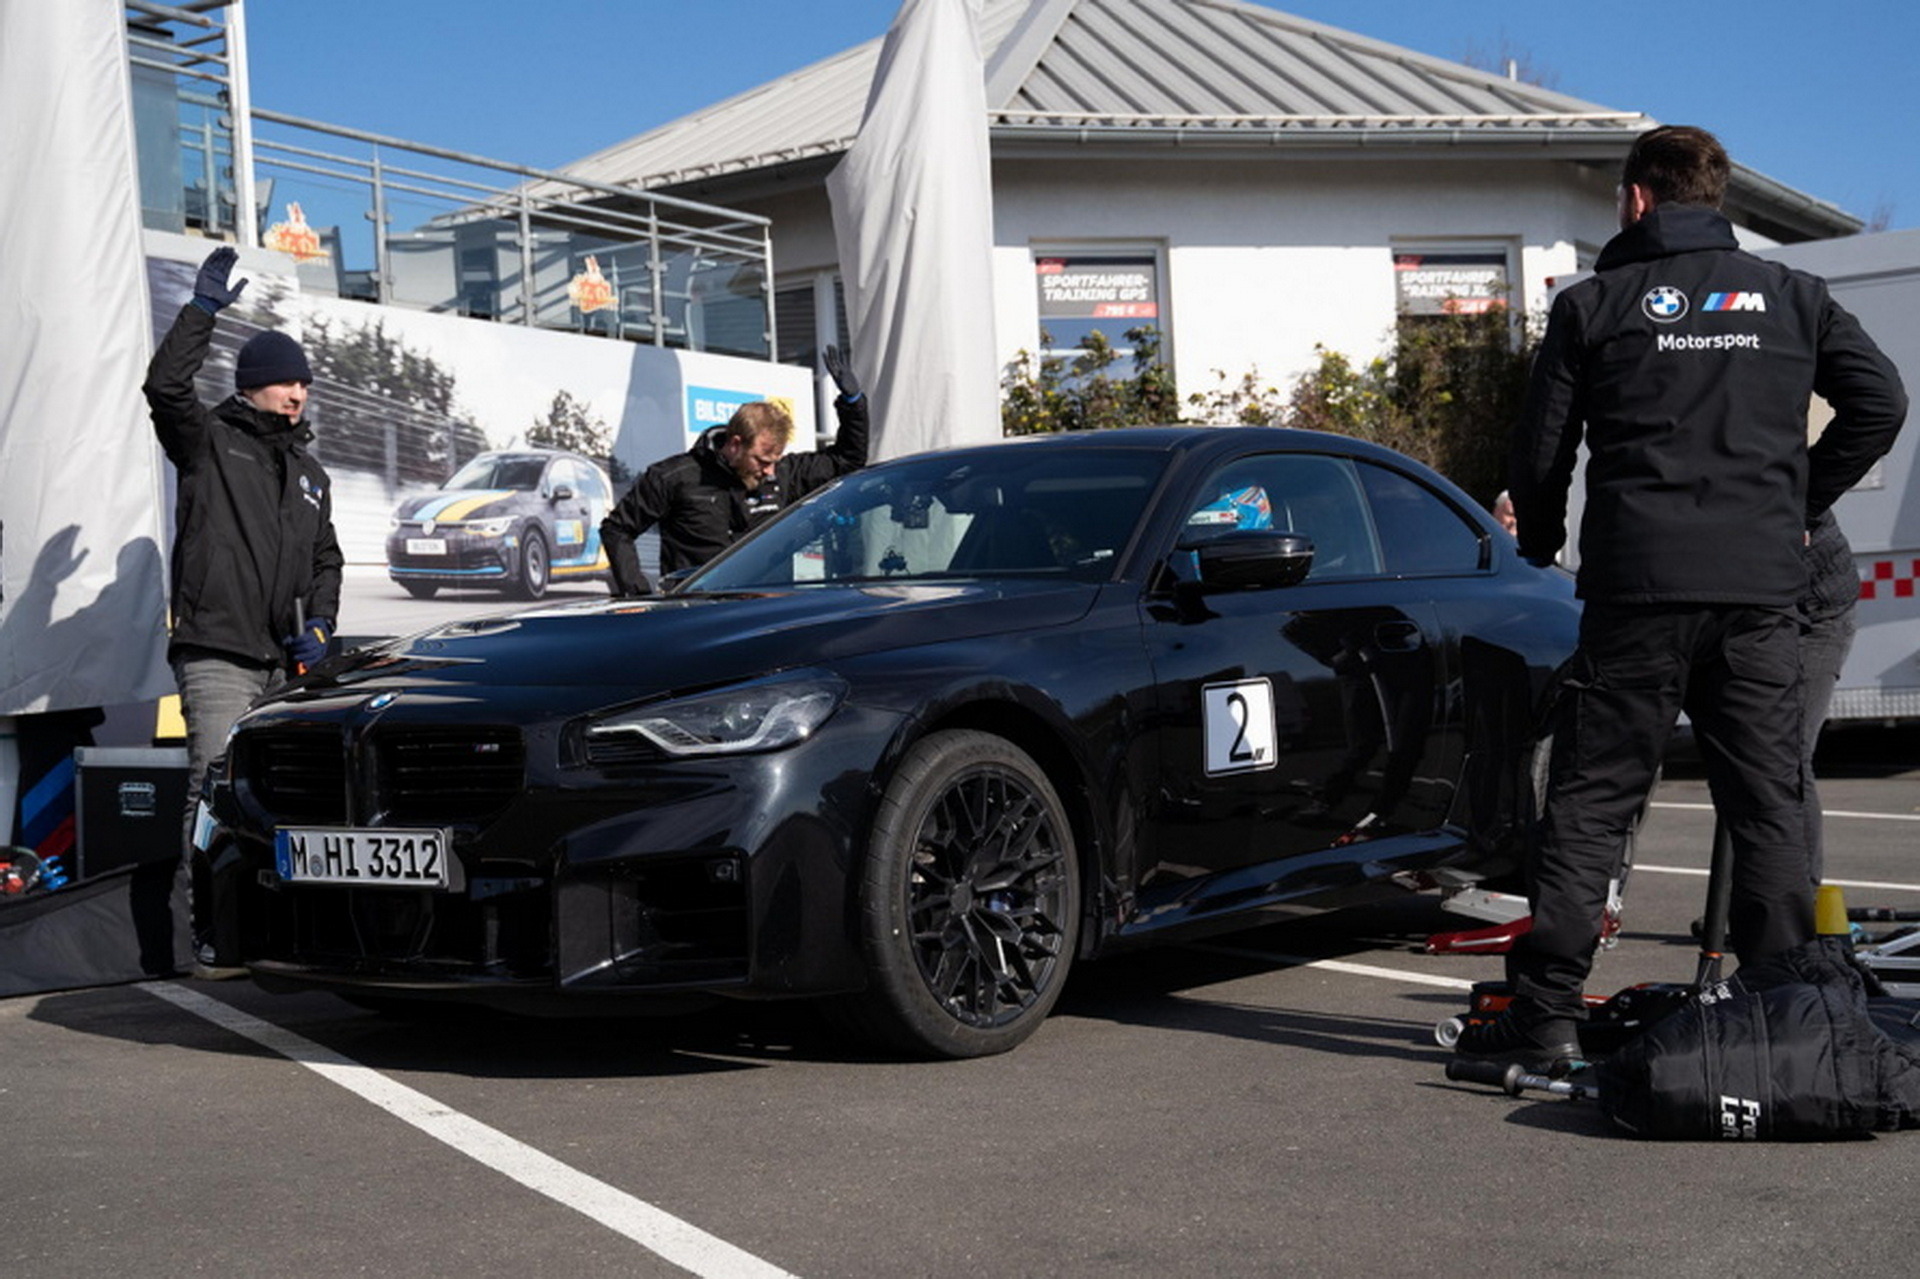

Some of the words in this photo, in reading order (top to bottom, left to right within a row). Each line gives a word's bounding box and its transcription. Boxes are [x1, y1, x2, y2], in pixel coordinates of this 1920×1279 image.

[1042, 273, 1150, 288] SPORTFAHRER-
[1044, 288, 1117, 301] TRAINING
[1118, 288, 1149, 301] GPS
[1657, 333, 1760, 352] Motorsport
[695, 399, 740, 422] BILST
[290, 836, 308, 875] M
[324, 836, 360, 877] HI
[367, 838, 440, 879] 3312
